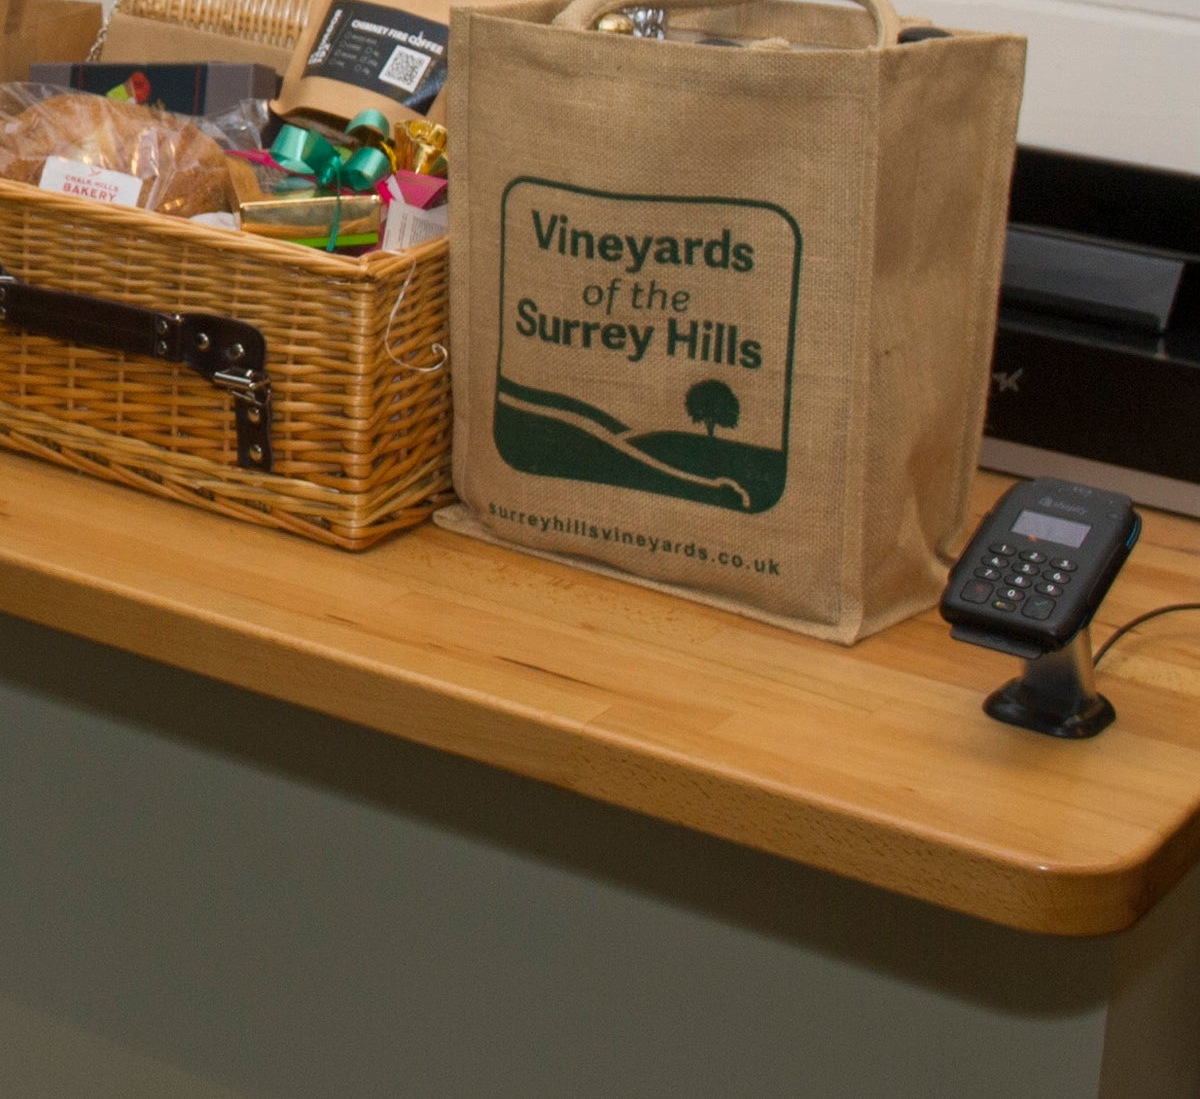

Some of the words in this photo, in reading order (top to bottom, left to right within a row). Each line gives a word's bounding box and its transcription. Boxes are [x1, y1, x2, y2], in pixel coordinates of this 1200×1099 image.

[351, 19, 388, 36] CHIMNEY
[388, 28, 408, 42] FIRE
[408, 33, 444, 56] COFFEE
[63, 182, 117, 202] BAKERY
[65, 174, 92, 185] CHALK
[95, 181, 119, 192] HILLS
[530, 209, 756, 273] Vineyards
[582, 278, 622, 315] of
[631, 280, 691, 313] the
[515, 297, 655, 362] Surrey
[666, 318, 763, 370] Hills
[487, 501, 781, 576] surreyhillsvineyards.co.uk
[992, 557, 999, 565] 4
[1053, 573, 1061, 581] 6
[1015, 576, 1023, 584] 8
